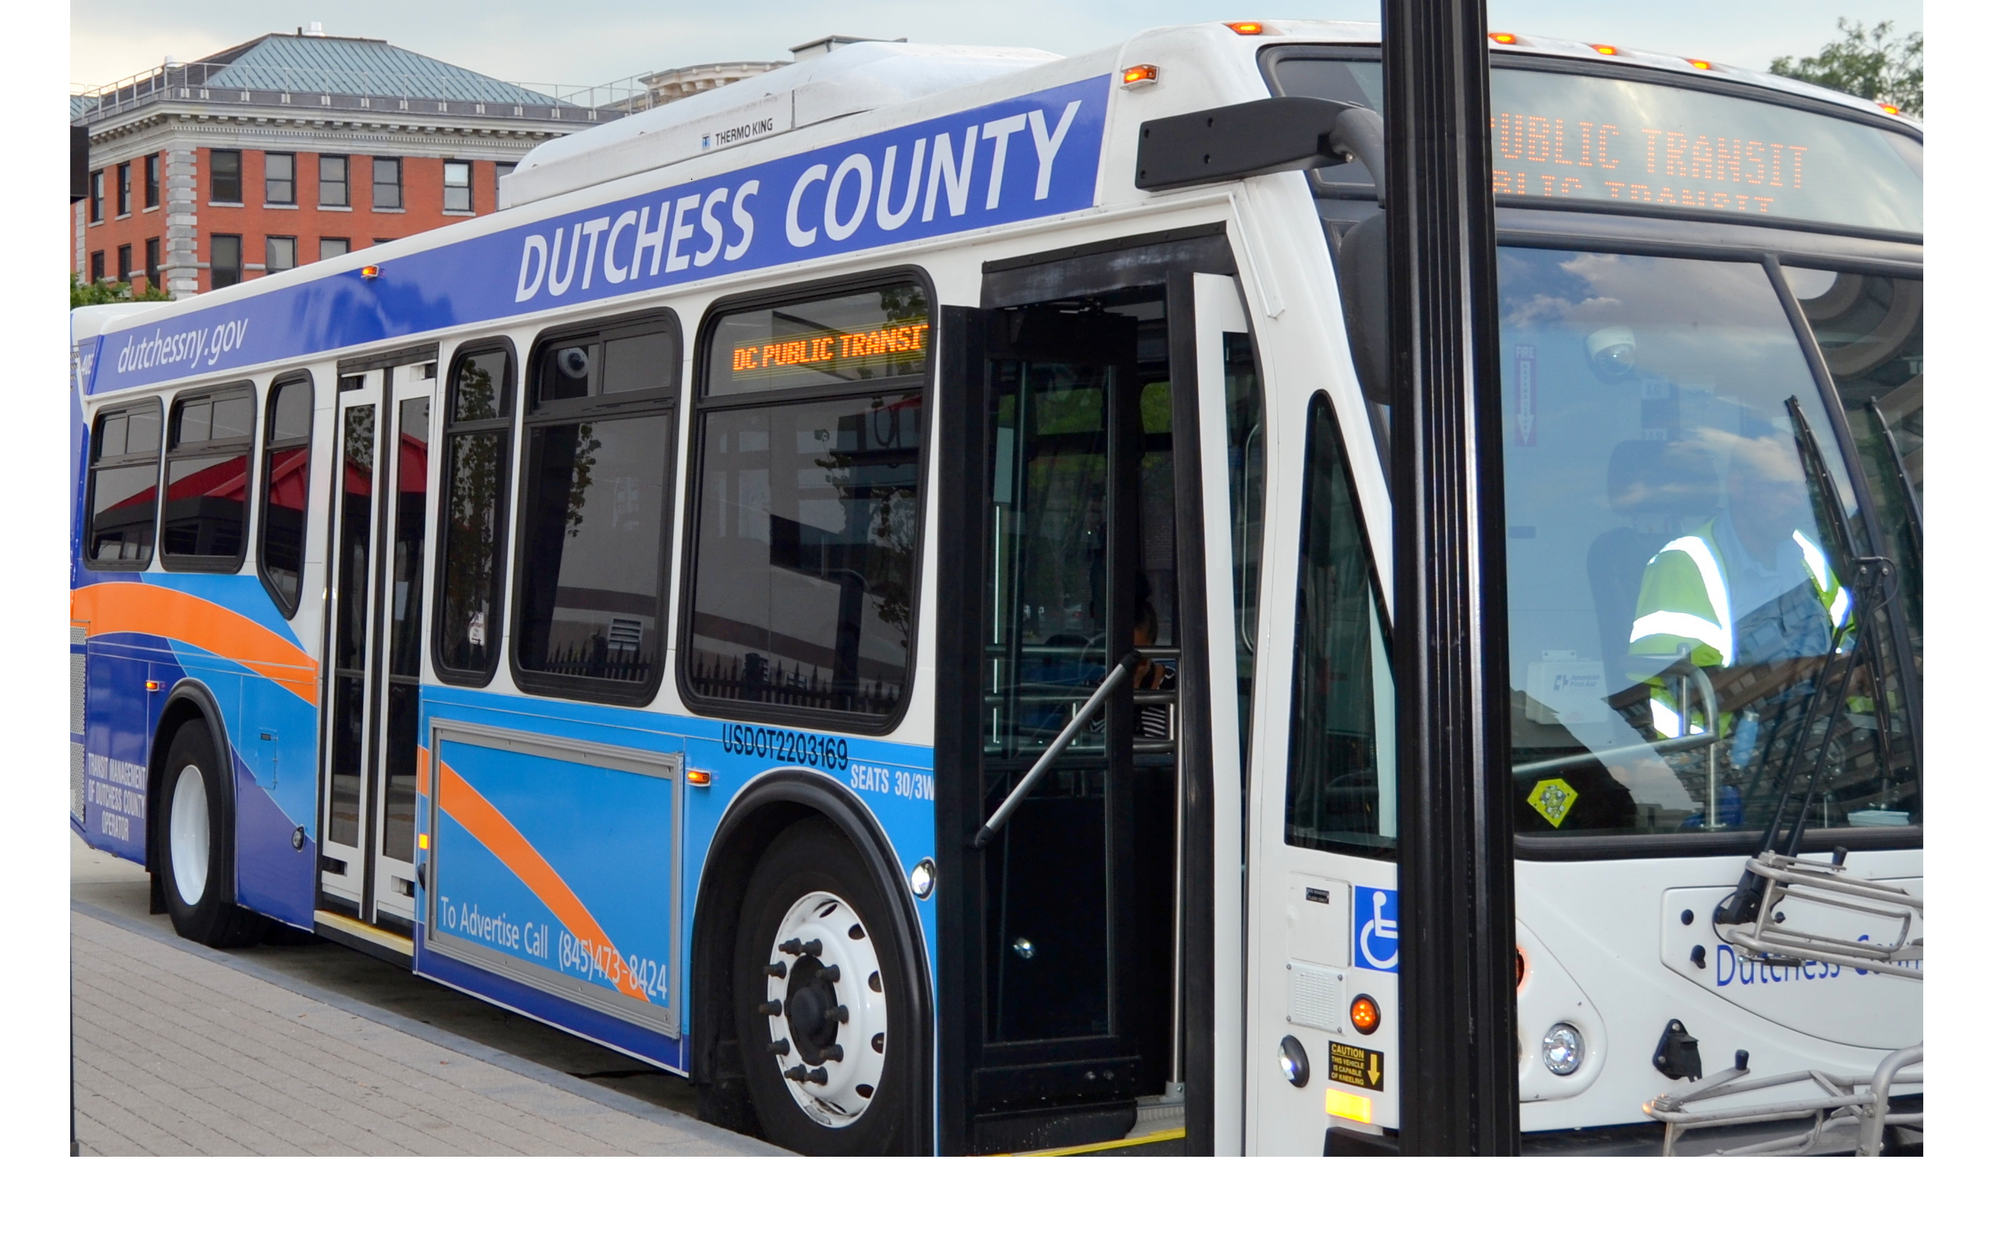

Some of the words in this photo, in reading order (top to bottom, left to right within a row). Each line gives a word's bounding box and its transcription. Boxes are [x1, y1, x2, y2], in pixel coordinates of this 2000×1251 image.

[715, 124, 751, 146] THERMO
[752, 117, 773, 136] KING
[1491, 112, 1619, 169] UBLIC
[1642, 129, 1807, 188] TRANSIT
[515, 180, 759, 302] DUTCHESS
[785, 100, 1082, 247] COUNTY
[118, 318, 248, 373] dutchessny.gov
[733, 347, 758, 371] DC
[762, 337, 834, 367] PUBLIC
[840, 324, 929, 358] TRANSI
[722, 723, 848, 771] USDOT2203169
[88, 752, 109, 780] TRANSIT
[109, 758, 146, 791] MANAGEMENT
[850, 764, 889, 794] SEATS
[88, 779, 95, 803] OF
[96, 781, 122, 812] DUTCHESS
[123, 789, 146, 819] COUNTY
[102, 810, 129, 842] OPERATOR
[441, 896, 456, 929] To
[460, 902, 520, 950] Advertise
[524, 922, 548, 960] Call
[558, 930, 668, 1000] (845)473-8424
[1331, 1043, 1365, 1059] CAUTION
[1331, 1055, 1342, 1064] THIS
[1343, 1058, 1364, 1069] VEHICLE
[1339, 1066, 1362, 1077] CAPABLE
[1339, 1074, 1365, 1085] KNEELING
